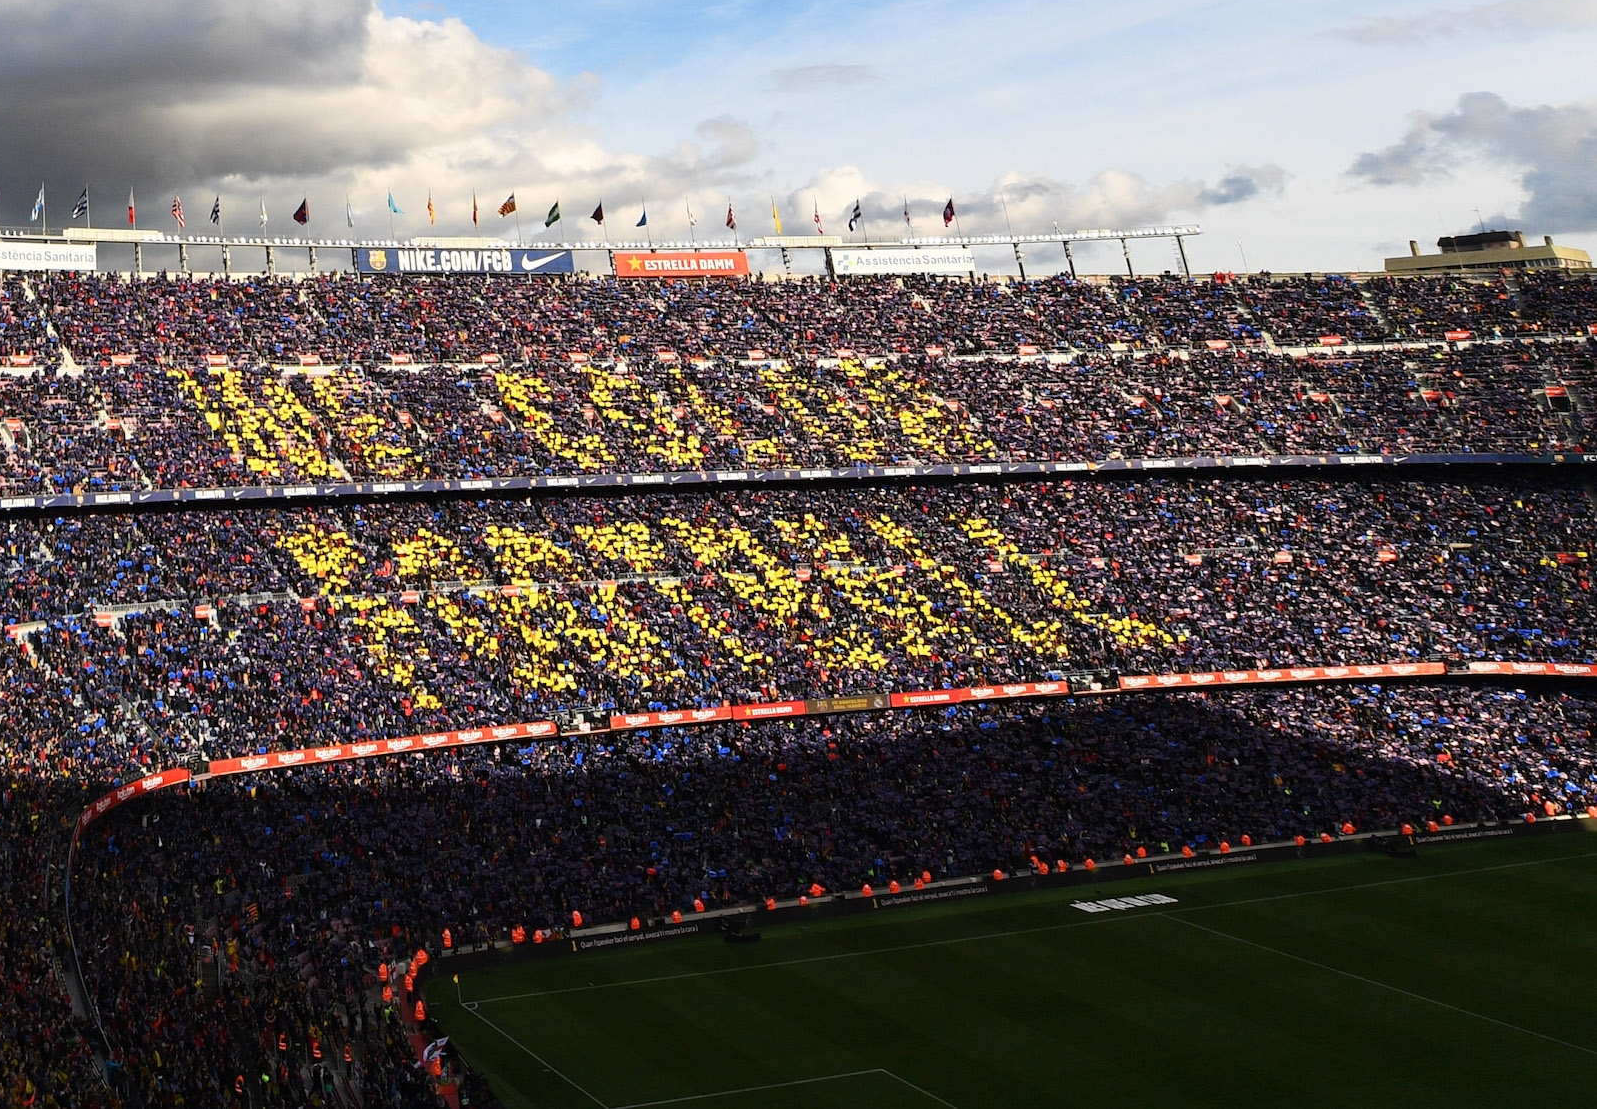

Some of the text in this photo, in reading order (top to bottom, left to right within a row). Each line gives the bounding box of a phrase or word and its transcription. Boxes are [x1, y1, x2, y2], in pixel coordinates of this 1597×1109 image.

[44, 251, 94, 262] Sanitària
[398, 250, 512, 271] NIKE.COM/FCB
[856, 255, 921, 266] Assistència
[644, 259, 734, 270] ESTRELLA DAMM
[1583, 454, 1597, 462] FC
[1512, 662, 1546, 671] Rakuten
[1554, 663, 1591, 673] Rakuten
[315, 747, 341, 759] Rakuten
[352, 743, 377, 754] Rakuten
[241, 757, 267, 769] Rakuten
[278, 752, 305, 764] Rakuten
